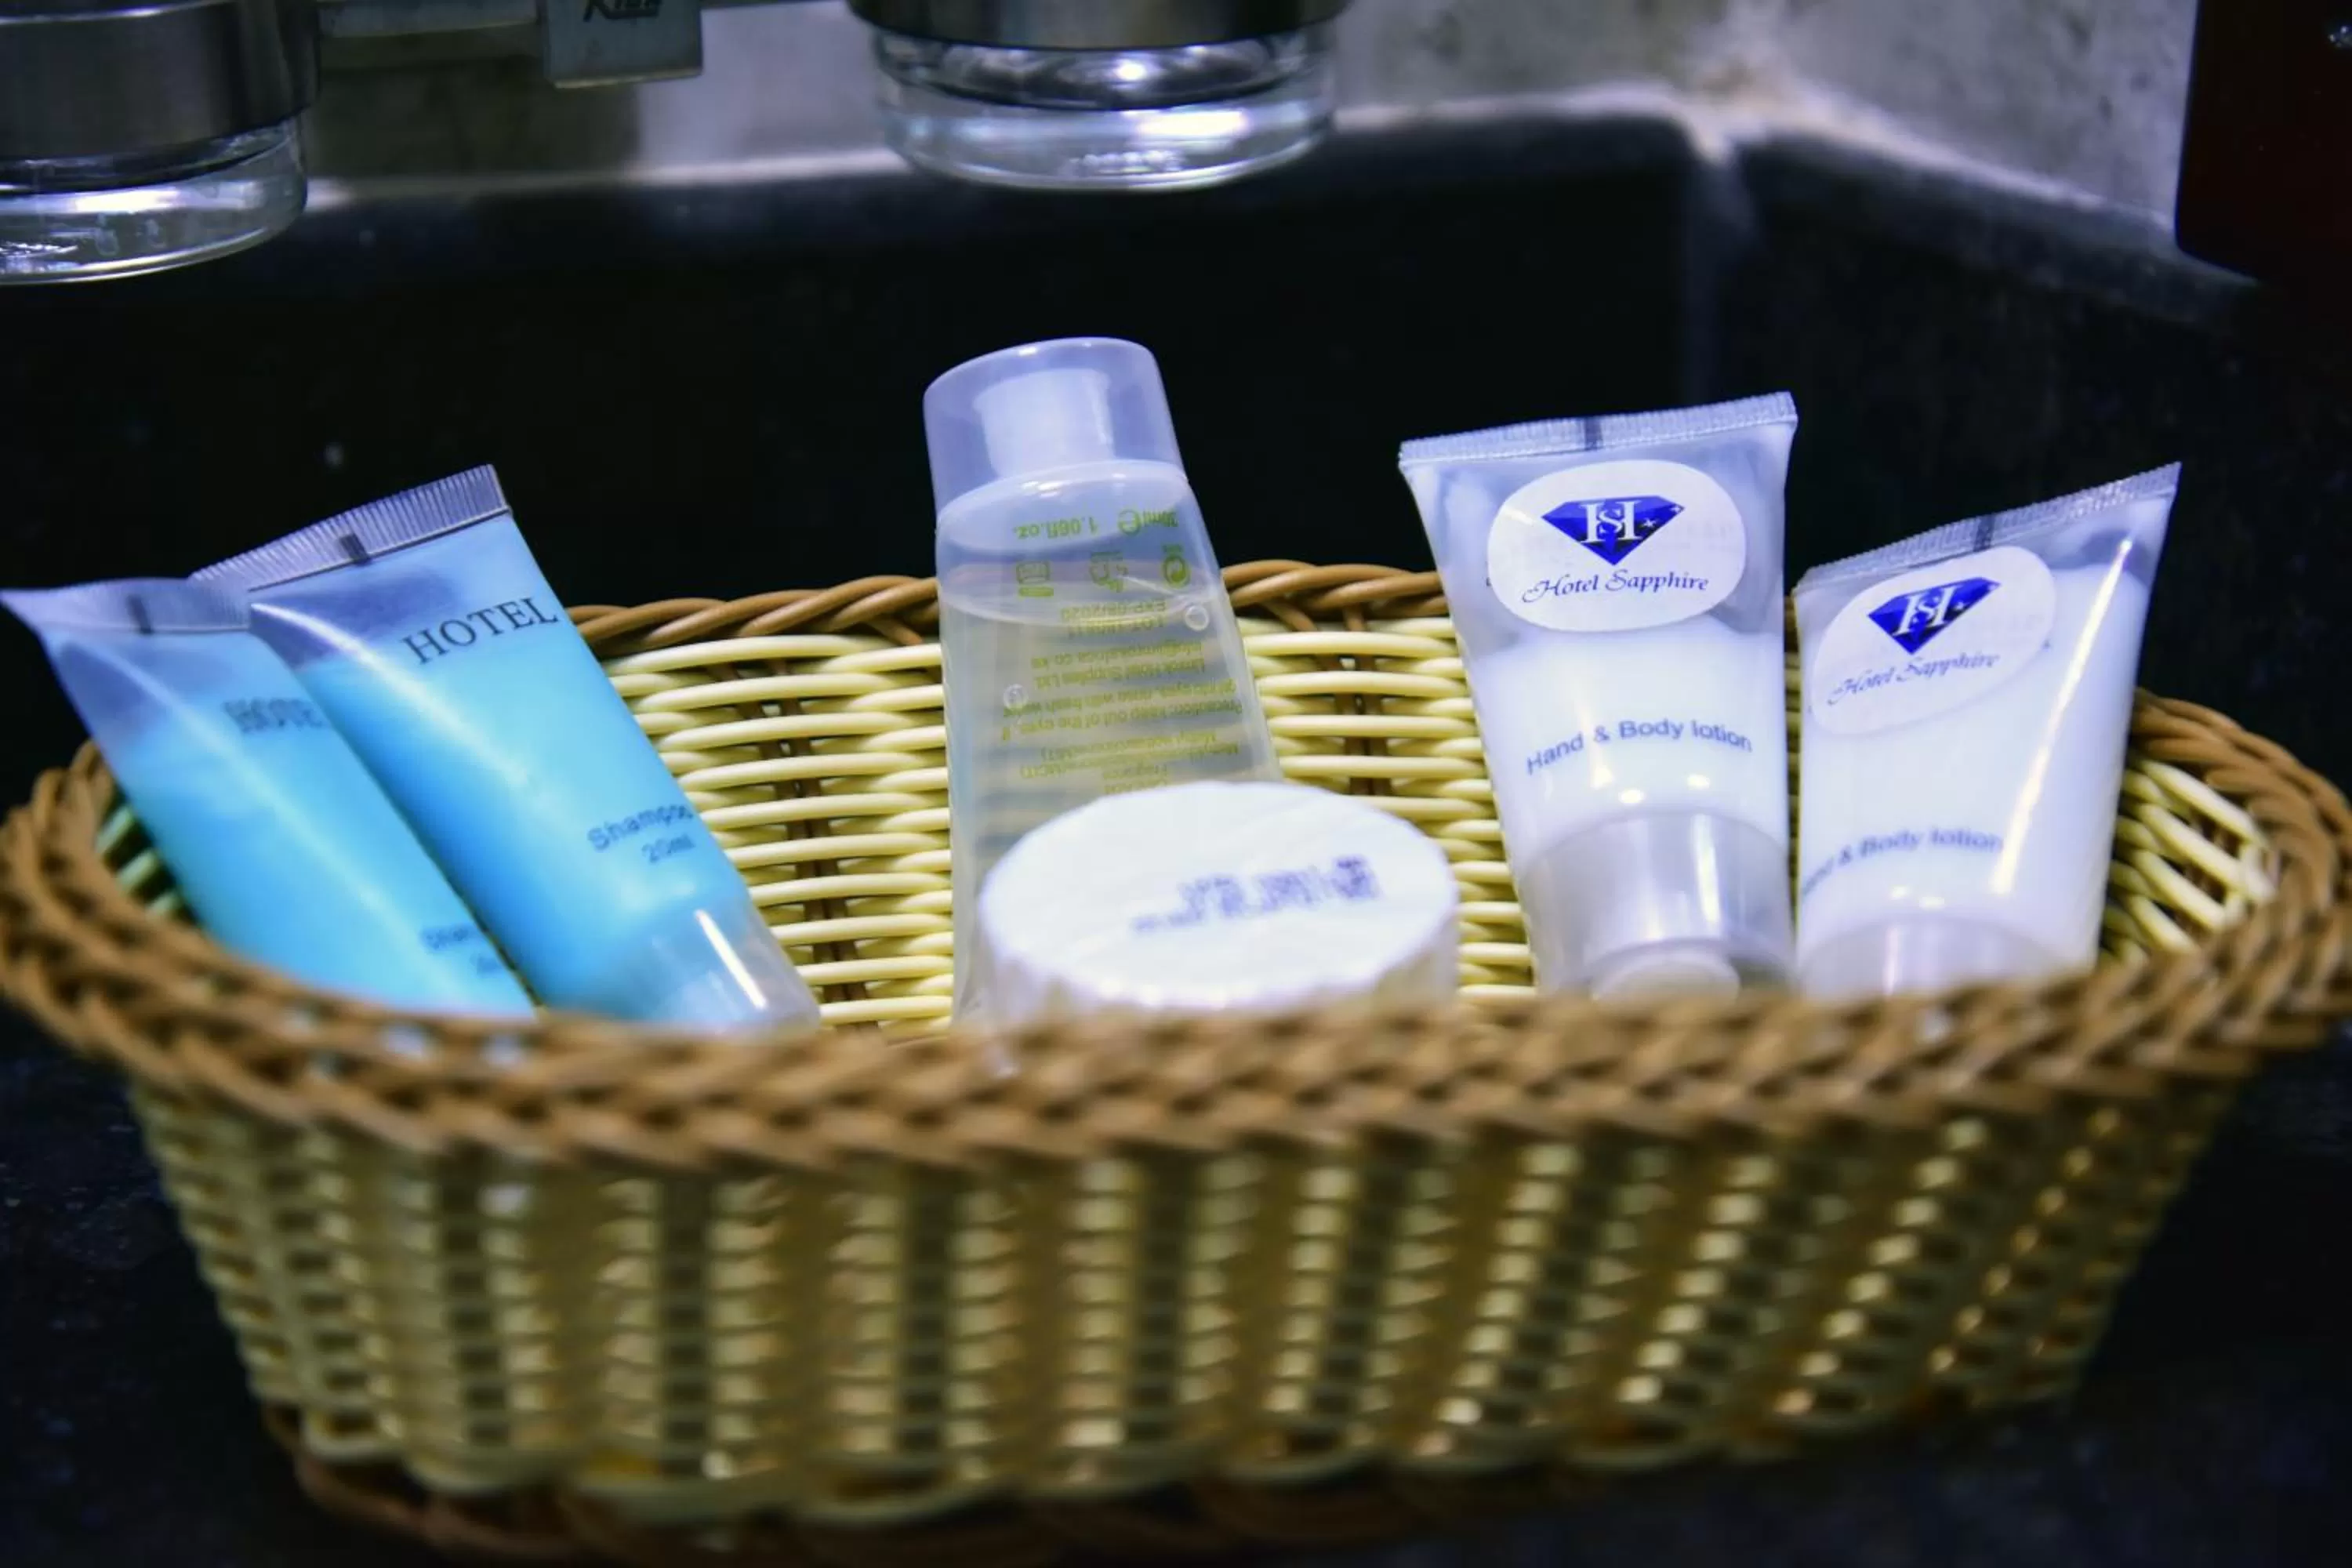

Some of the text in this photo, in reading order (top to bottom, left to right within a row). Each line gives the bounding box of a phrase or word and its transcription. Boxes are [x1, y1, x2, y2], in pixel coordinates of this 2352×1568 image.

[1522, 568, 1709, 604] Hotel Sapphire
[401, 596, 560, 665] HOTEL
[1827, 652, 2001, 706] Hotel Sapphire
[1527, 717, 1753, 775] Hand & Body lotion
[1860, 830, 1922, 858] Body
